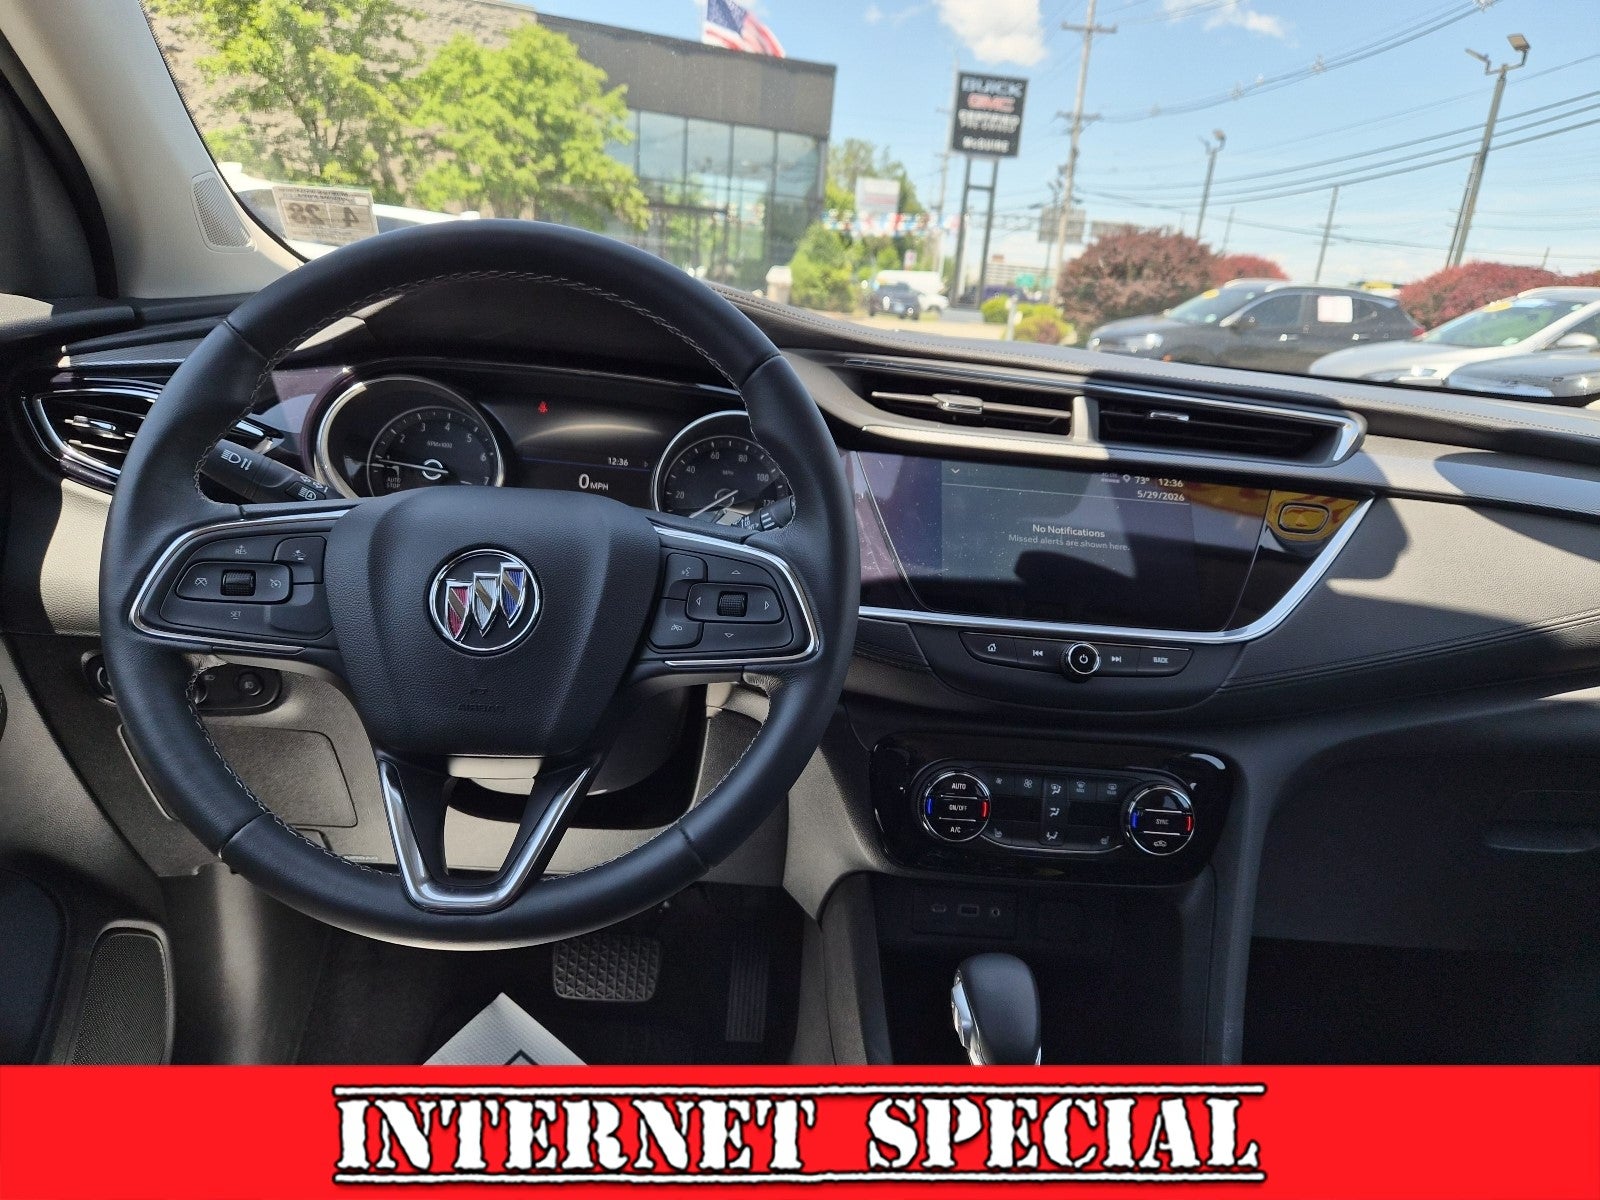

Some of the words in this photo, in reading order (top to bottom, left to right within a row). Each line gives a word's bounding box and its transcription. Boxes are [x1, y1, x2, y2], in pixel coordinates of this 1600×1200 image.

[967, 92, 1016, 113] GMC
[420, 422, 427, 432] 3
[444, 422, 451, 432] 4
[399, 434, 406, 444] 2
[466, 432, 473, 443] 5
[479, 452, 487, 462] 6
[710, 451, 720, 460] 60
[738, 454, 748, 463] 80
[607, 456, 629, 467] 12:36
[686, 465, 696, 474] 40
[578, 473, 590, 489] 0
[590, 482, 609, 491] MPH
[756, 473, 769, 482] 100
[1134, 476, 1151, 485] 73°
[1158, 478, 1184, 488] 12:36
[675, 490, 685, 499] 20
[1137, 489, 1185, 502] 5/29/2026
[1032, 523, 1046, 533] No
[1047, 524, 1106, 538] Notifications
[1008, 534, 1038, 543] Missed
[1040, 535, 1064, 546] alerts
[1065, 538, 1079, 547] are
[1080, 540, 1107, 550] shown
[1109, 542, 1131, 551] here.
[1152, 656, 1169, 664] BACK
[951, 782, 967, 790] AUTO
[950, 826, 962, 834] A/C
